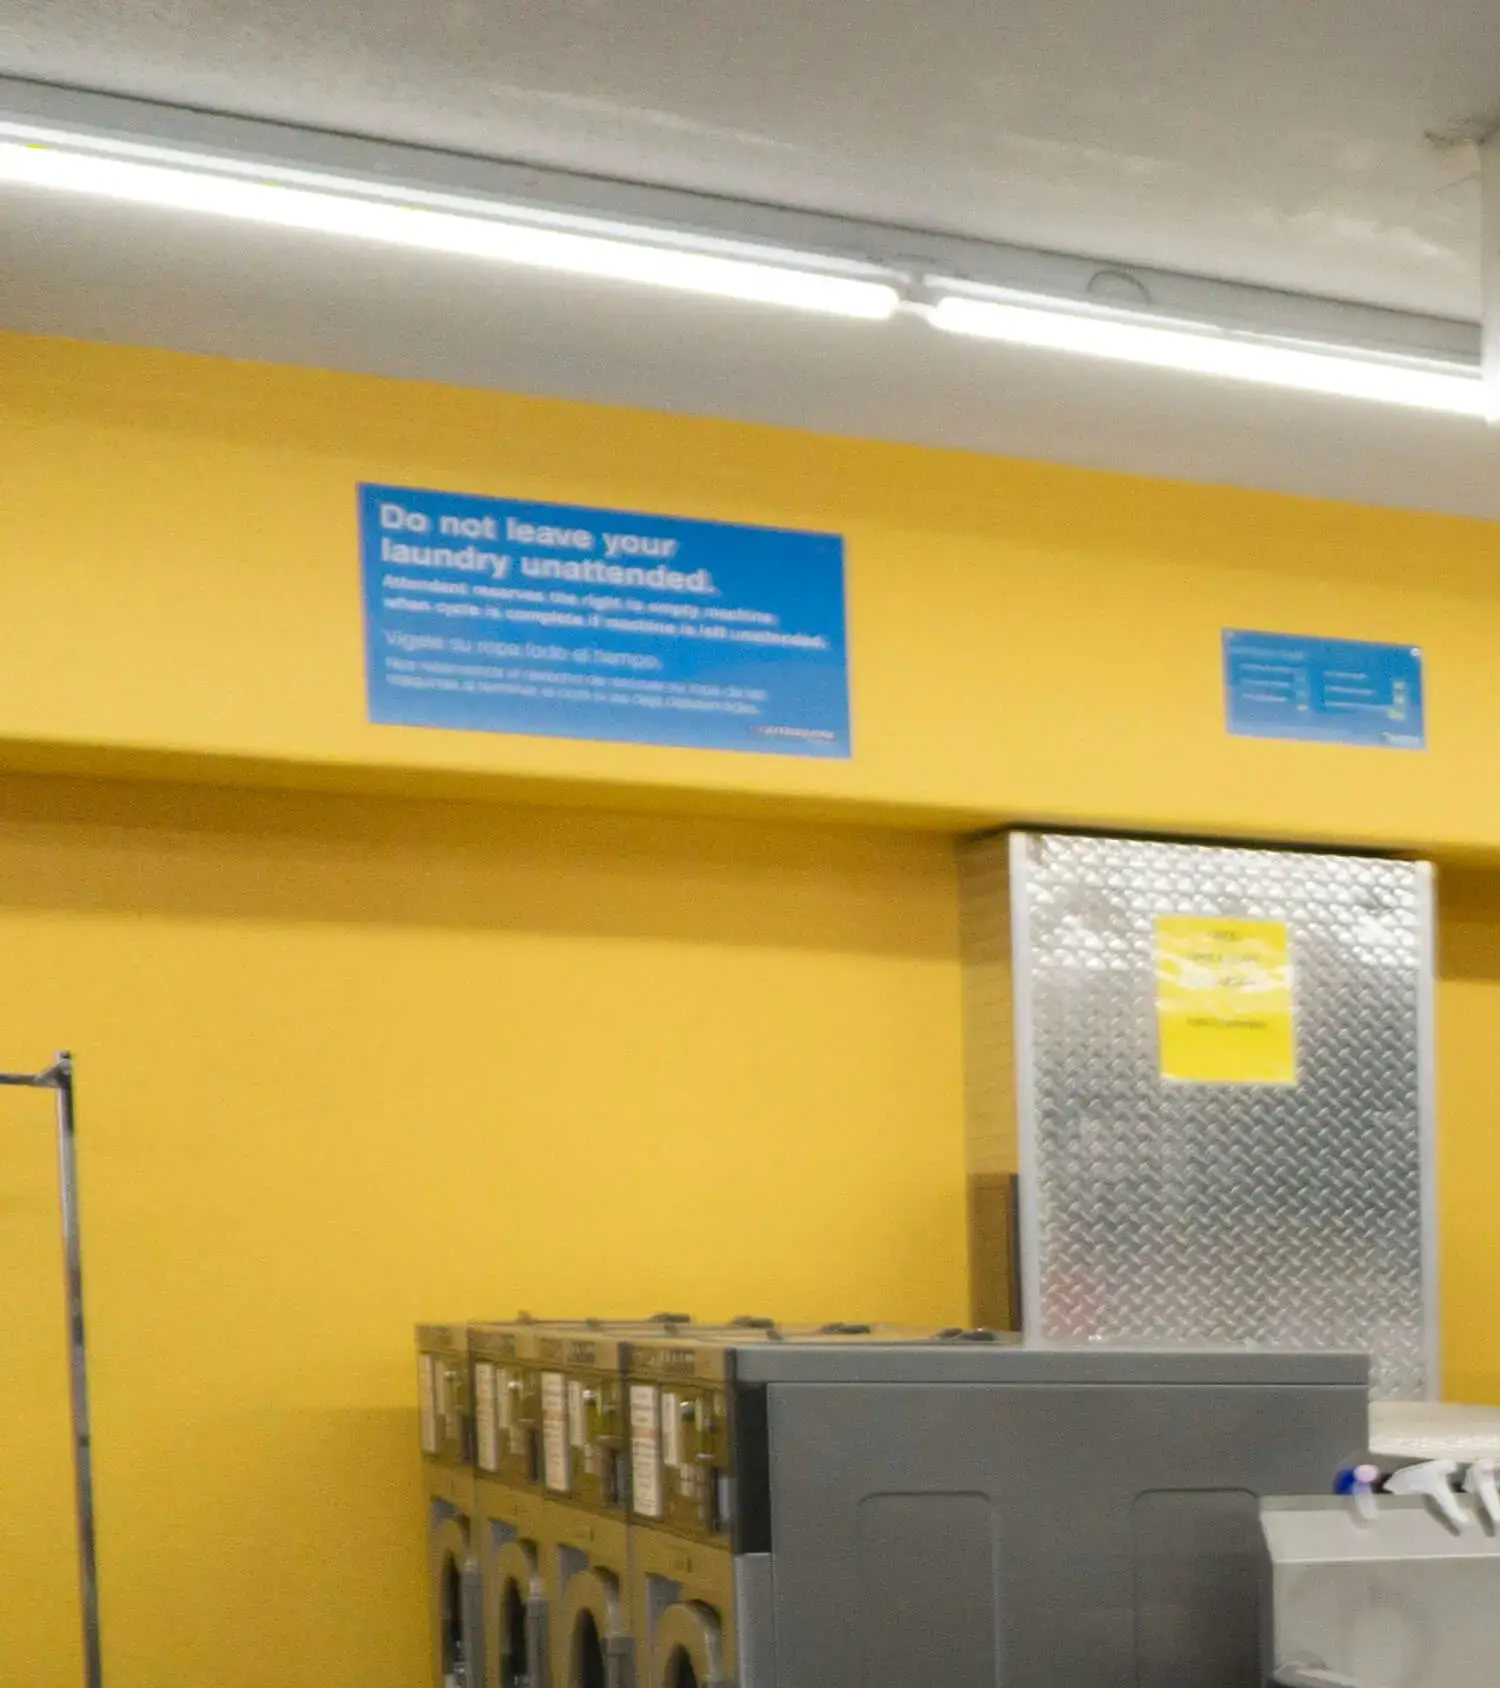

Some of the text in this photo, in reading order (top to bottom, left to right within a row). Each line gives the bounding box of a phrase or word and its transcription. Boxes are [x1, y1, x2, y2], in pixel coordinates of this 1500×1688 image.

[380, 503, 677, 557] Do not leave your
[381, 537, 717, 594] laundry unattended.
[505, 609, 584, 626] complete
